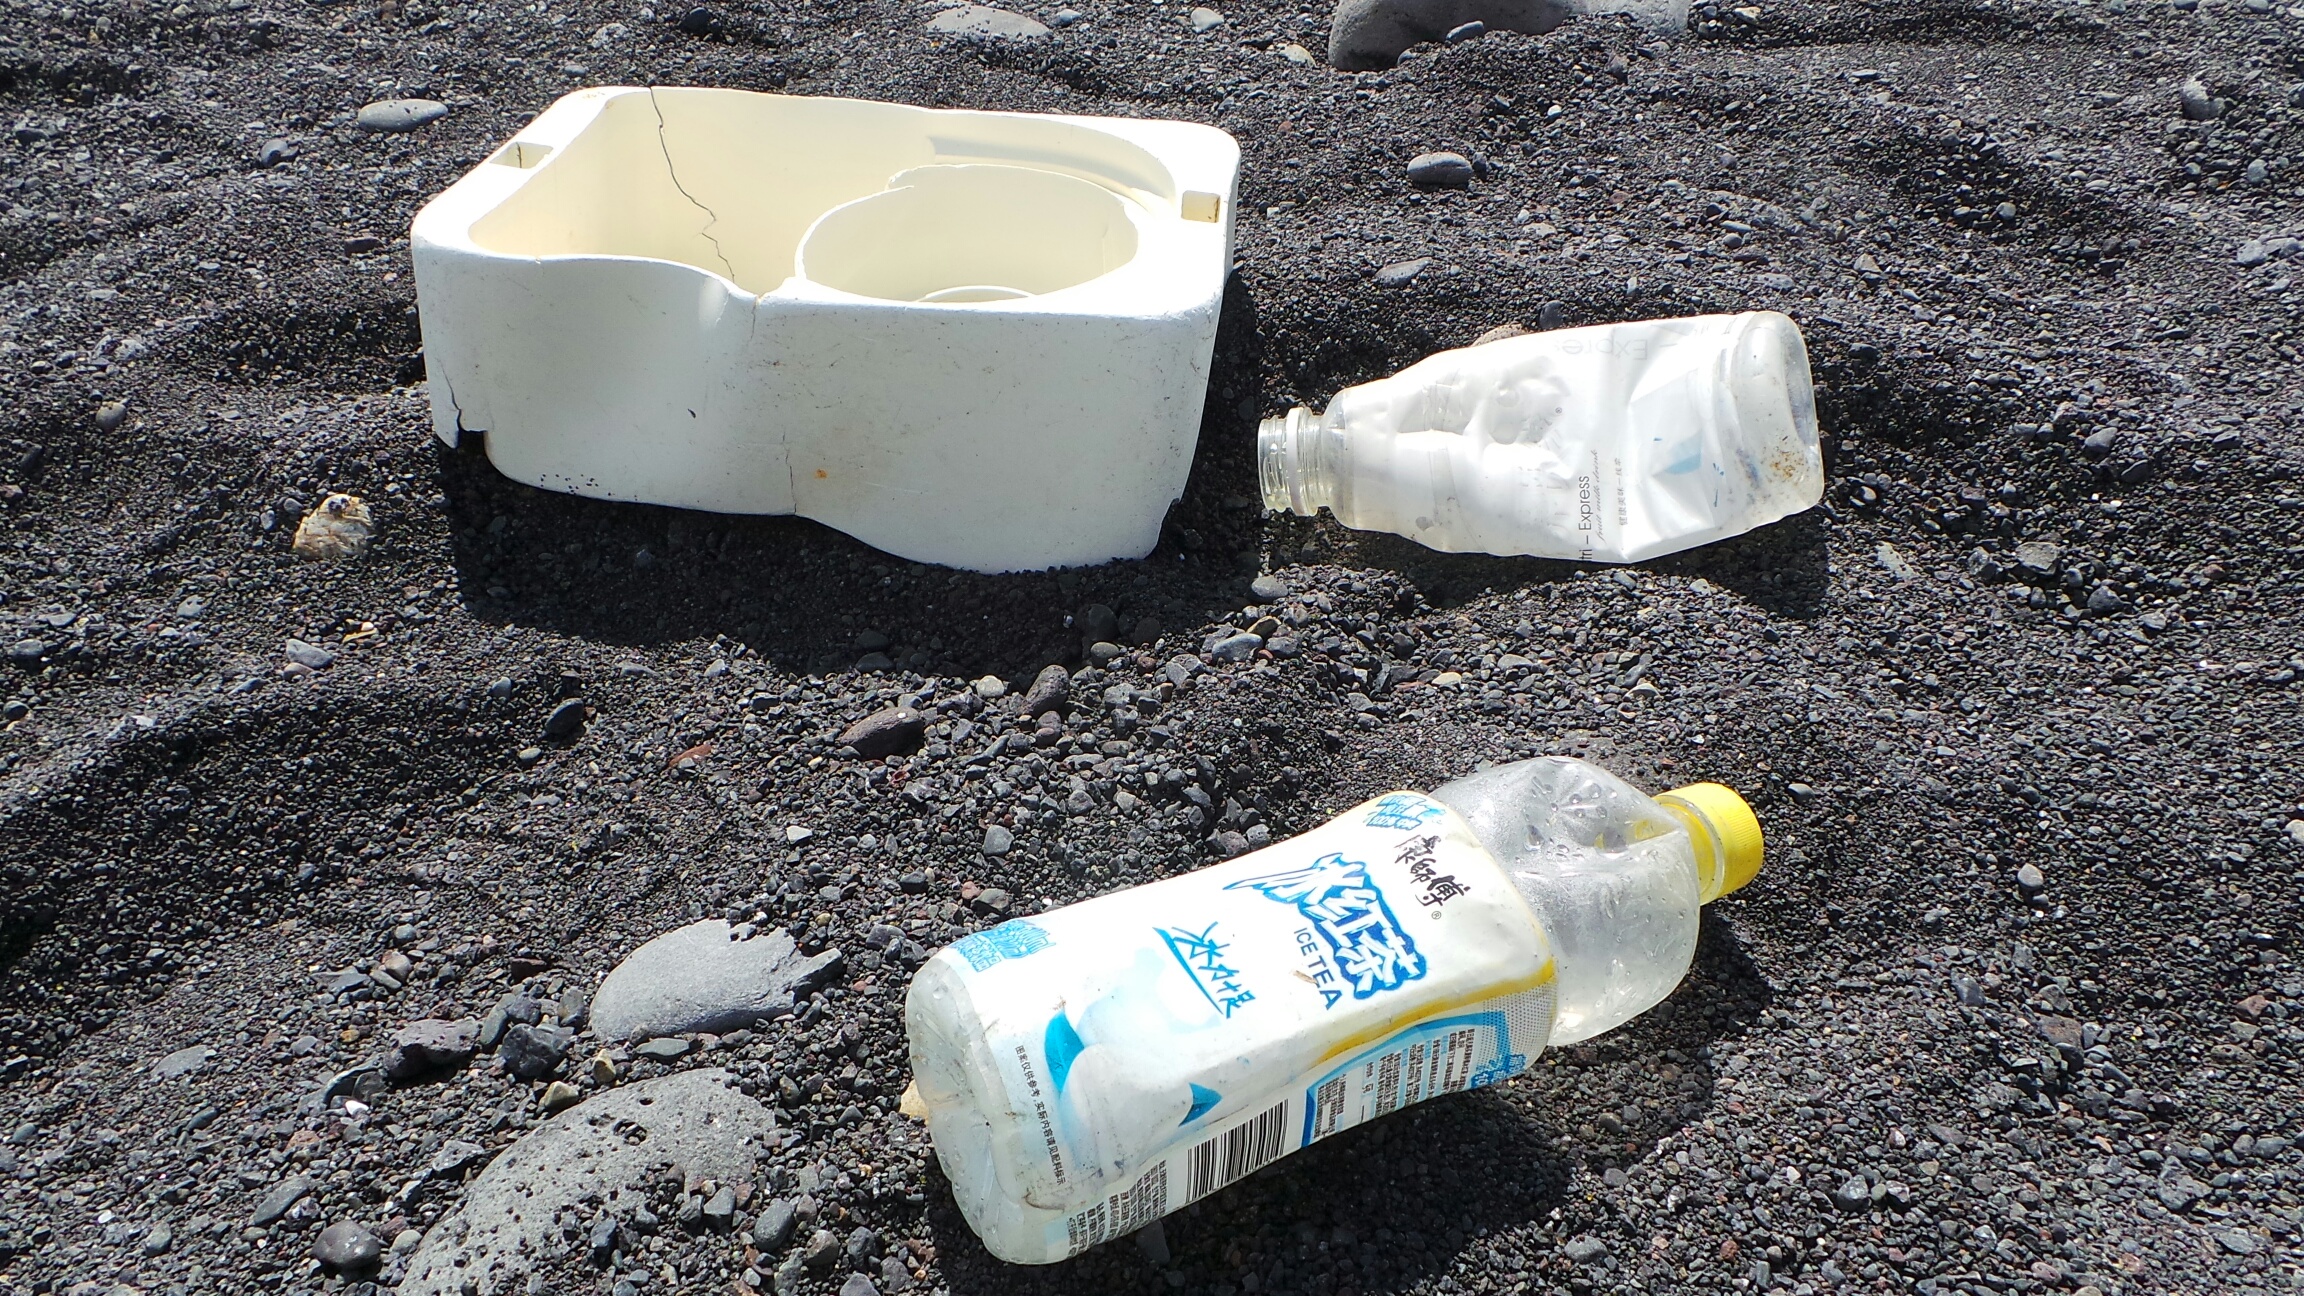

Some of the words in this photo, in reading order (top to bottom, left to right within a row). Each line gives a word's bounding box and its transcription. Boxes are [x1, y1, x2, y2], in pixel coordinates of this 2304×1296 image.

[1590, 449, 1600, 483] drink
[1578, 475, 1594, 531] Express
[1593, 485, 1602, 512] milk
[1223, 852, 1427, 1000] 冰红茶
[1293, 926, 1320, 957] ICE
[1307, 952, 1344, 1011] TEA
